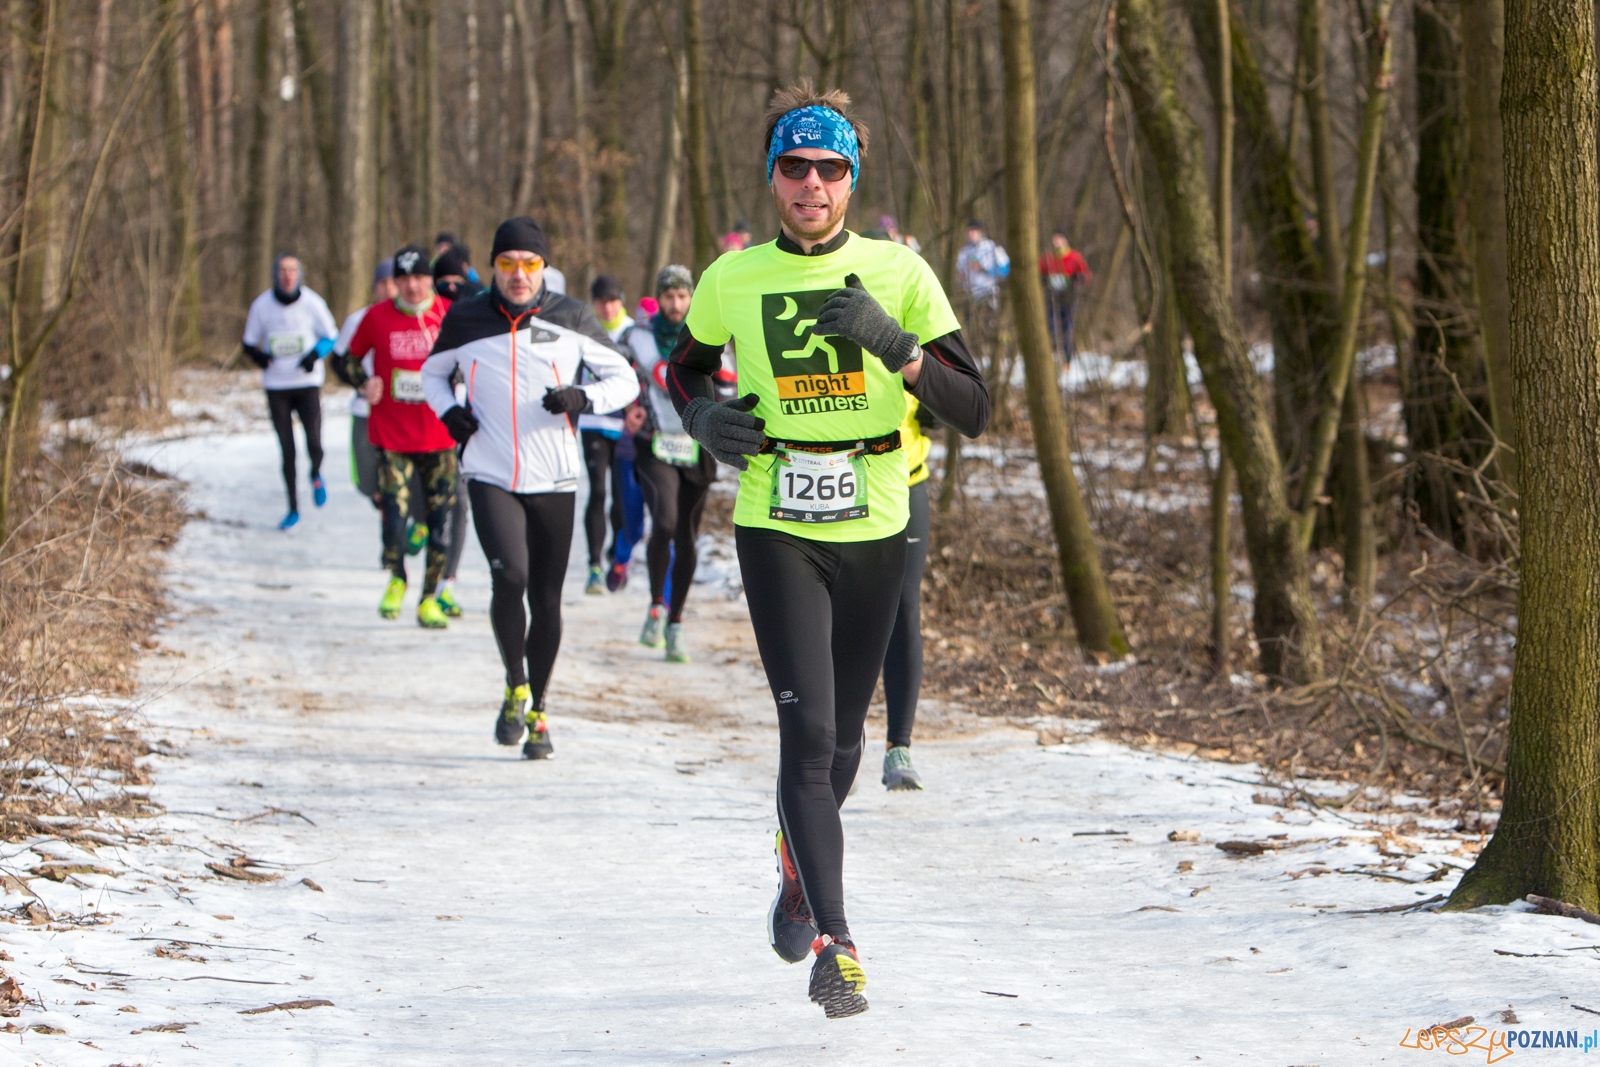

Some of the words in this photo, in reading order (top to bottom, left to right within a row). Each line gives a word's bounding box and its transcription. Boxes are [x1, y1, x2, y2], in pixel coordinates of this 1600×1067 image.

[792, 133, 822, 145] run
[794, 375, 850, 396] night
[781, 395, 868, 414] runners
[785, 472, 855, 500] 1266
